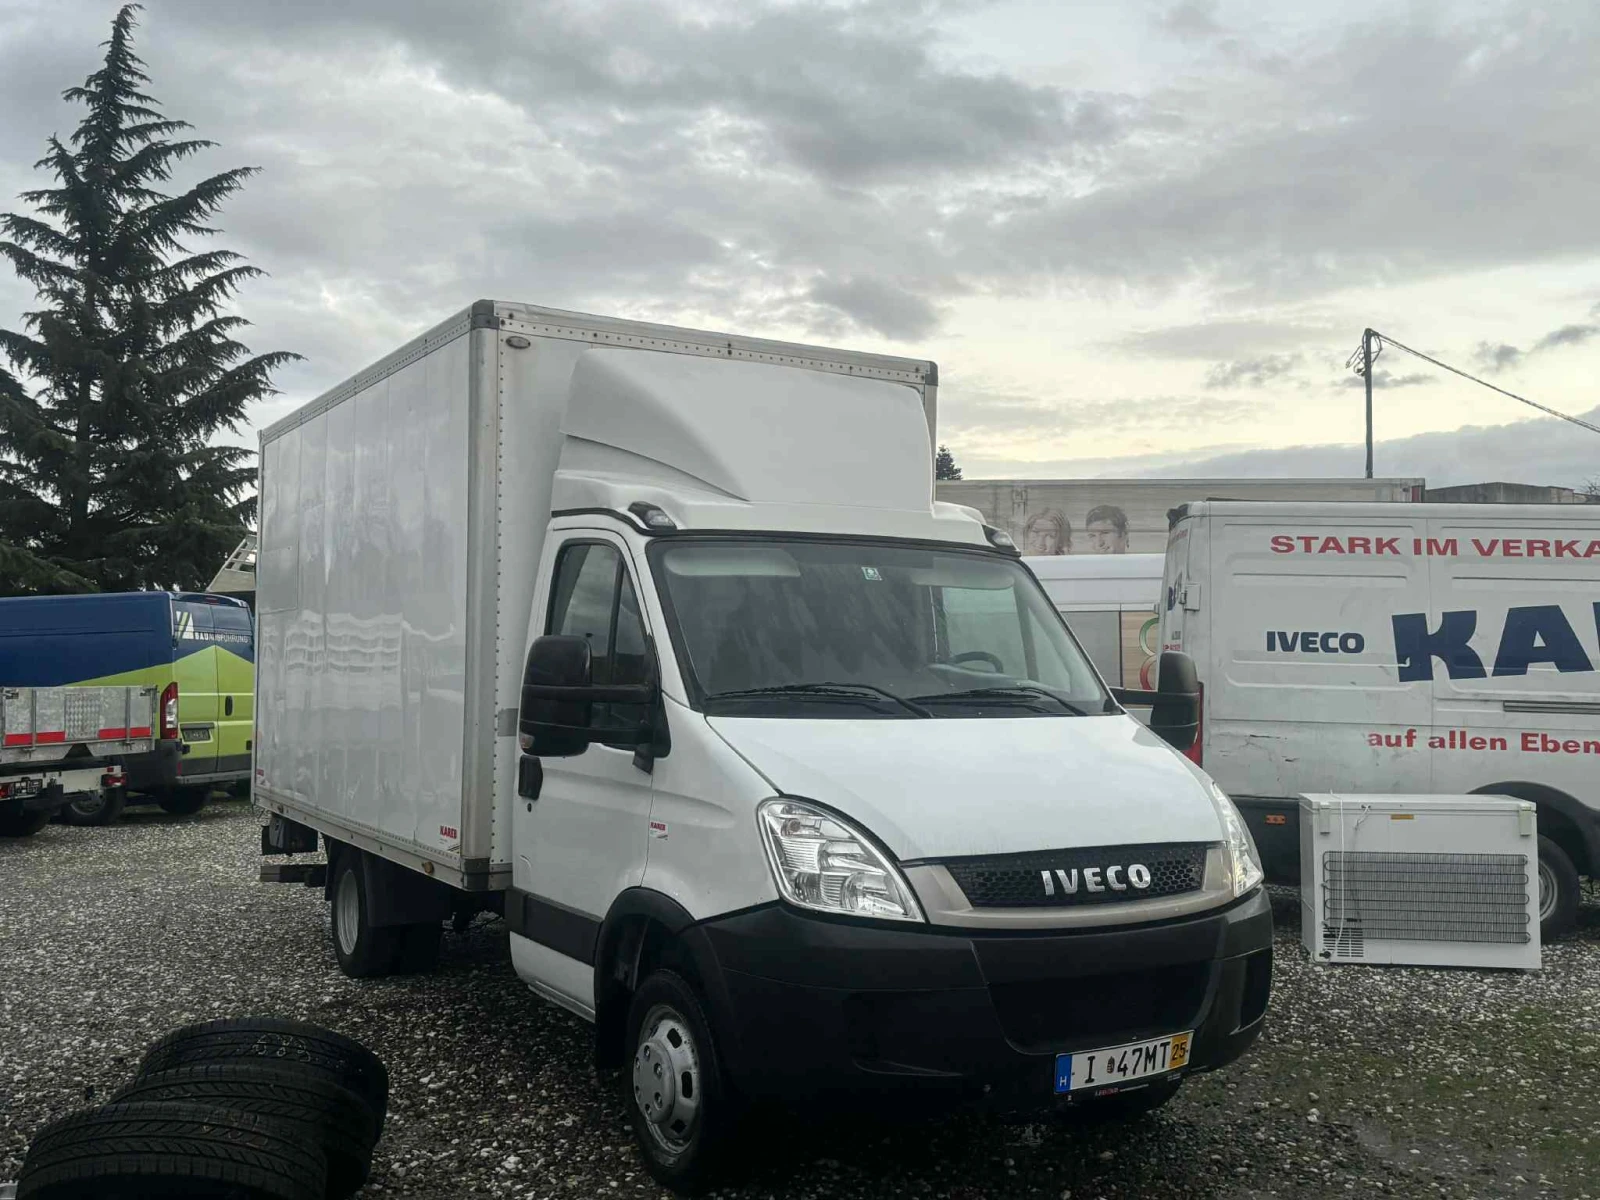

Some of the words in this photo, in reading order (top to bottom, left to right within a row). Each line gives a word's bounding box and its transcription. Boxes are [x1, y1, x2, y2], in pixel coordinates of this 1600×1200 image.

[1270, 535, 1401, 555] STARK
[1413, 538, 1459, 556] IM
[1471, 538, 1600, 559] VERKA
[1266, 631, 1365, 654] IVECO
[1391, 602, 1600, 683] KA
[1368, 729, 1417, 748] auf
[1428, 730, 1507, 751] allen
[1521, 732, 1600, 754] Eben
[1040, 863, 1152, 896] IVECO
[1171, 1040, 1187, 1061] 25
[1059, 1075, 1067, 1087] H
